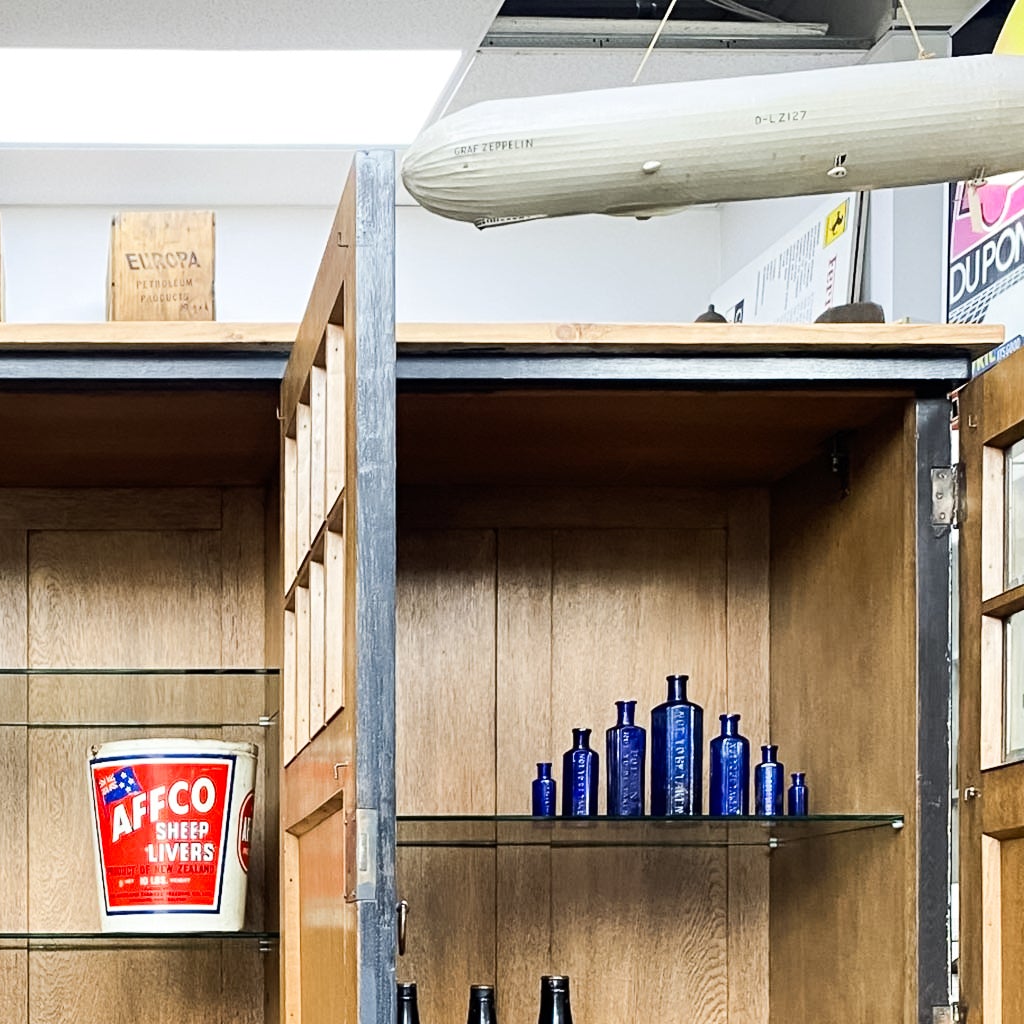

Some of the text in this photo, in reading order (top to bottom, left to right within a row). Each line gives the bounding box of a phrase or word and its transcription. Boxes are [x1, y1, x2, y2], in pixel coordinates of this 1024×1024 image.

[454, 138, 534, 155] GRAF ZEPPELIN
[125, 251, 201, 270] EUROPA
[136, 278, 193, 290] PETROLEUM
[111, 776, 216, 843] AFFCO
[155, 821, 210, 841] SHEEP
[146, 841, 215, 863] LIVERS
[139, 864, 150, 874] OF
[155, 864, 173, 875] NEW
[177, 863, 215, 874] ZEALAND
